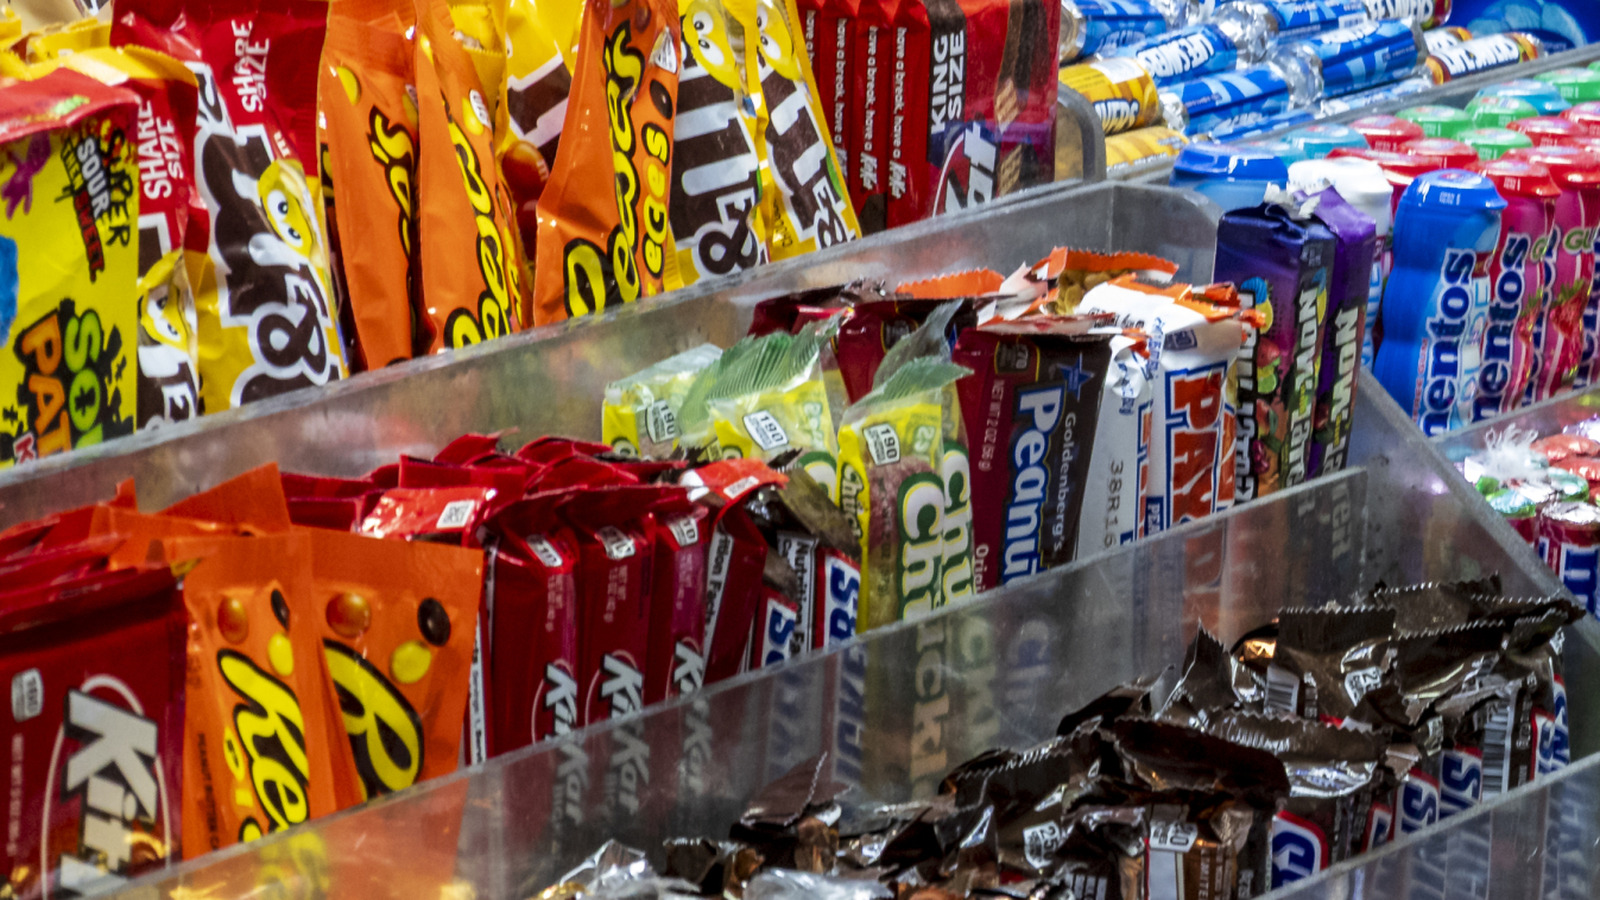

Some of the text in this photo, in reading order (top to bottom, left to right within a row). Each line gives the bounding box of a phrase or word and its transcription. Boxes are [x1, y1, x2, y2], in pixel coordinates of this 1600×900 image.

[806, 9, 816, 41] have
[835, 17, 847, 47] have
[867, 25, 879, 56] have
[836, 49, 846, 59] a
[895, 27, 907, 58] have
[231, 19, 264, 113] SHARE
[251, 37, 270, 104] SIZE
[867, 56, 877, 66] a
[895, 60, 905, 70] a
[948, 29, 966, 120] SIZE
[833, 59, 847, 101] break,
[864, 67, 878, 110] break,
[892, 71, 906, 114] break,
[930, 35, 948, 134] KING
[834, 103, 846, 133] have
[863, 109, 877, 139] have
[892, 115, 905, 146] have
[138, 99, 173, 200] SHARE
[156, 116, 185, 181] SIZE
[863, 141, 874, 151] a
[892, 147, 902, 158] a
[76, 137, 110, 219] SOUR
[103, 128, 135, 247] SUPER
[760, 415, 784, 442] 190
[880, 427, 898, 460] 190
[1051, 411, 1077, 551] Goldenberg's
[63, 689, 158, 872] Kit
